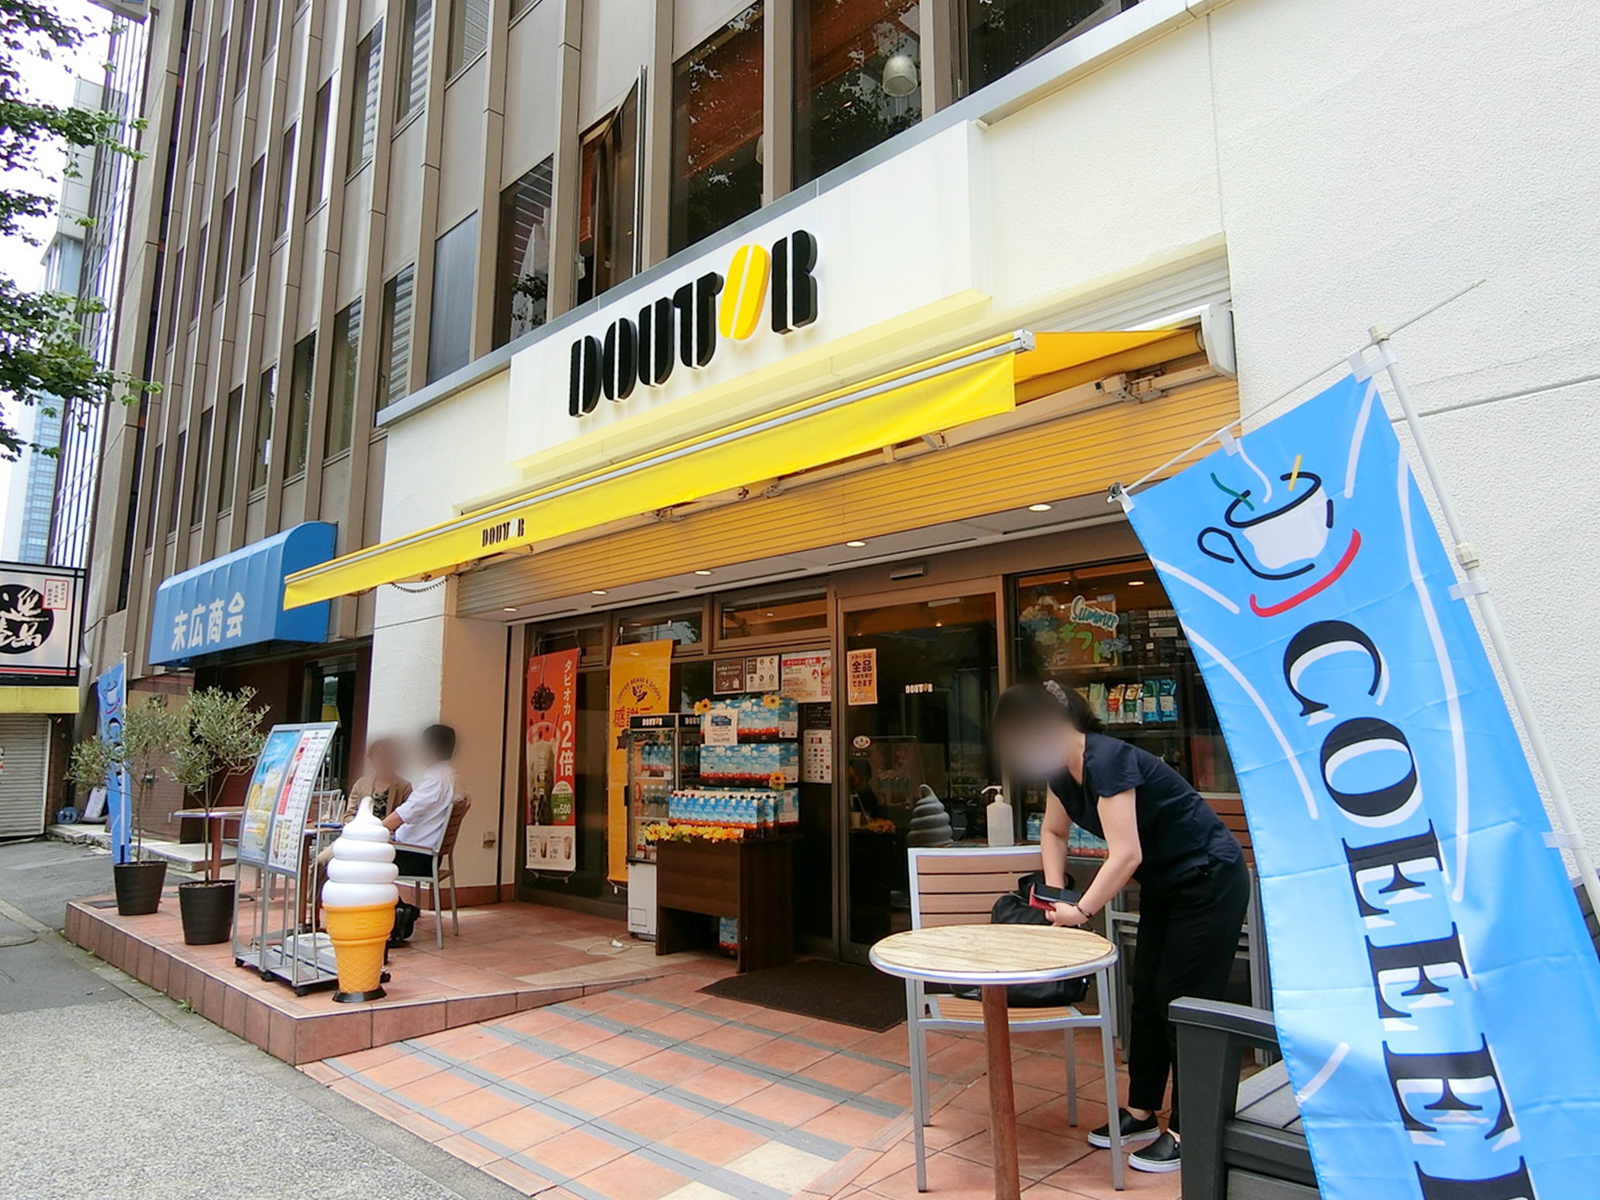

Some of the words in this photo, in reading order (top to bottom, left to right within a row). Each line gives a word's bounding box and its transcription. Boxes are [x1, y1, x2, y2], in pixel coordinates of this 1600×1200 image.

[569, 229, 818, 418] DOUTOR
[171, 592, 245, 652] 末広商会
[1071, 595, 1119, 630] Summer
[563, 659, 573, 716] タピオカ
[852, 659, 873, 673] 全品
[852, 679, 873, 687] できます
[558, 720, 574, 777] 2倍
